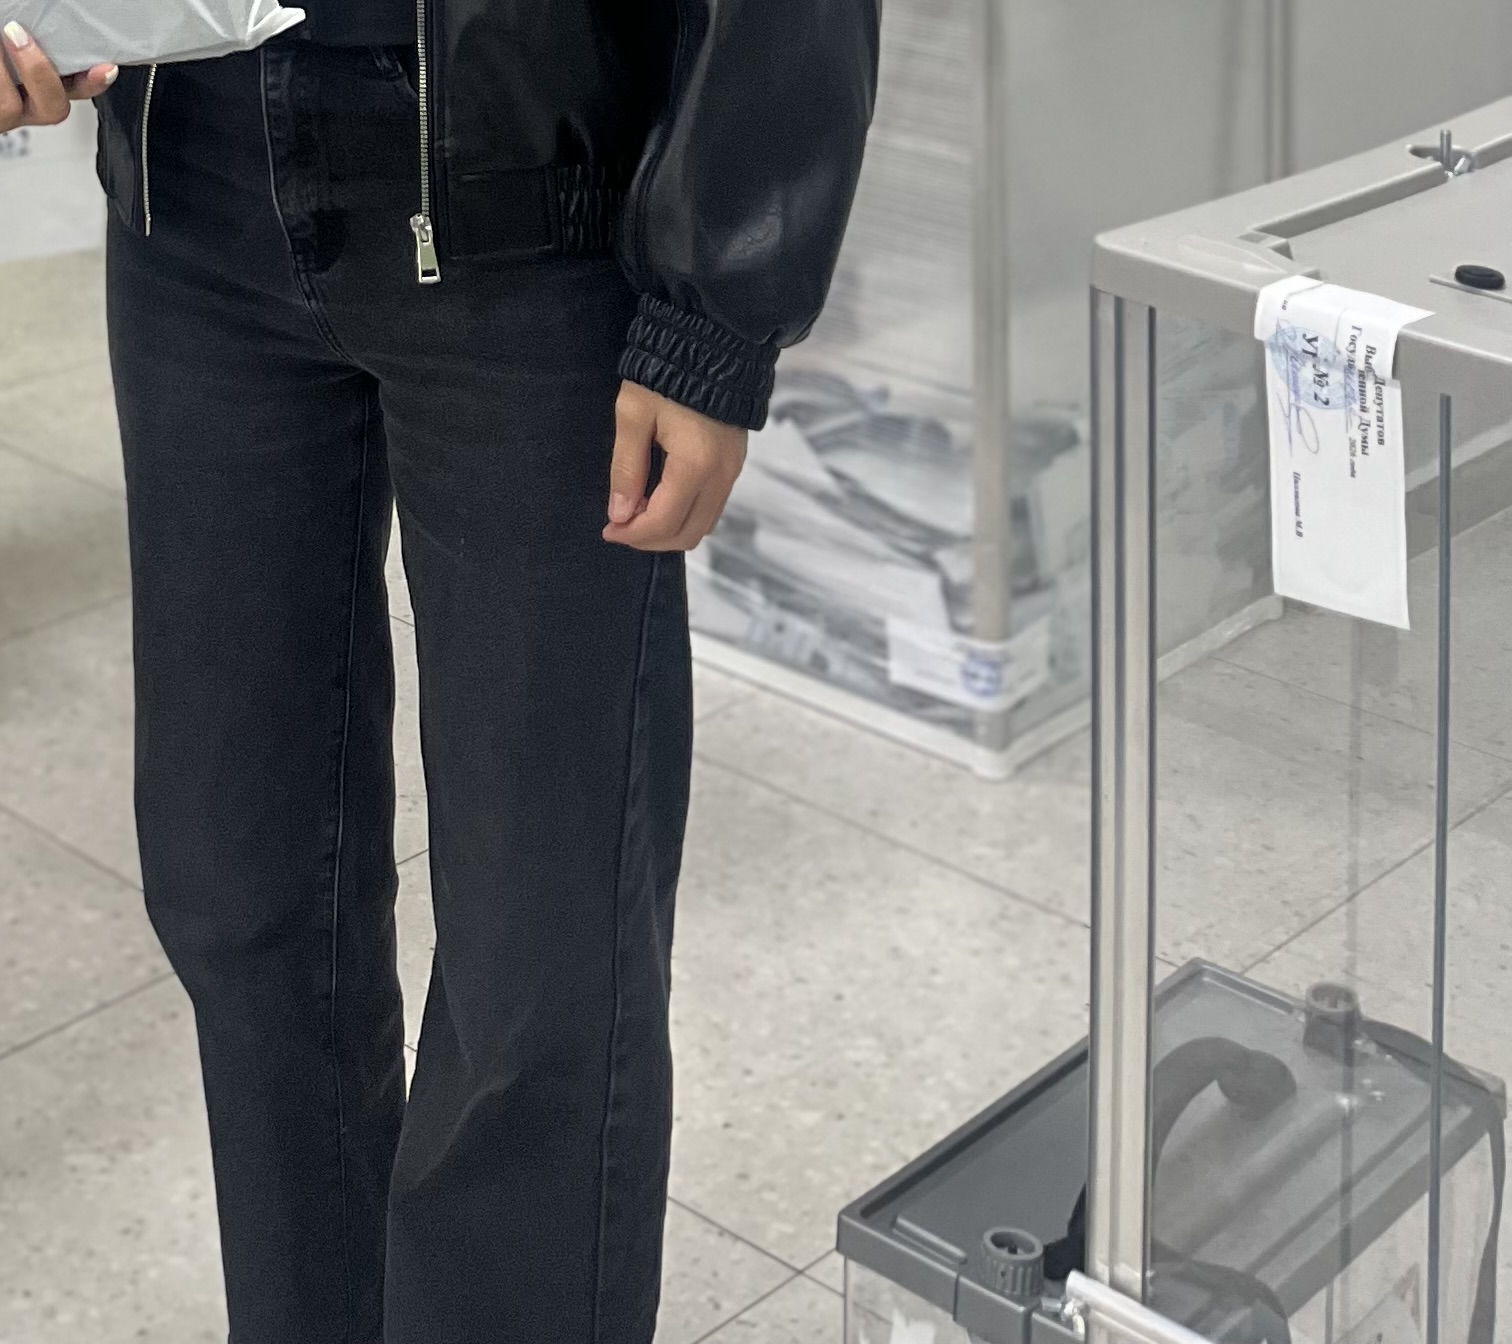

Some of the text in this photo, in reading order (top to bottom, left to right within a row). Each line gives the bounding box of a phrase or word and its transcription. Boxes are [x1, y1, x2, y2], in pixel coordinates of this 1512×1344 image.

[1312, 363, 1330, 407] № 2
[1374, 378, 1386, 446] Депутатов
[1358, 414, 1372, 456] Думы
